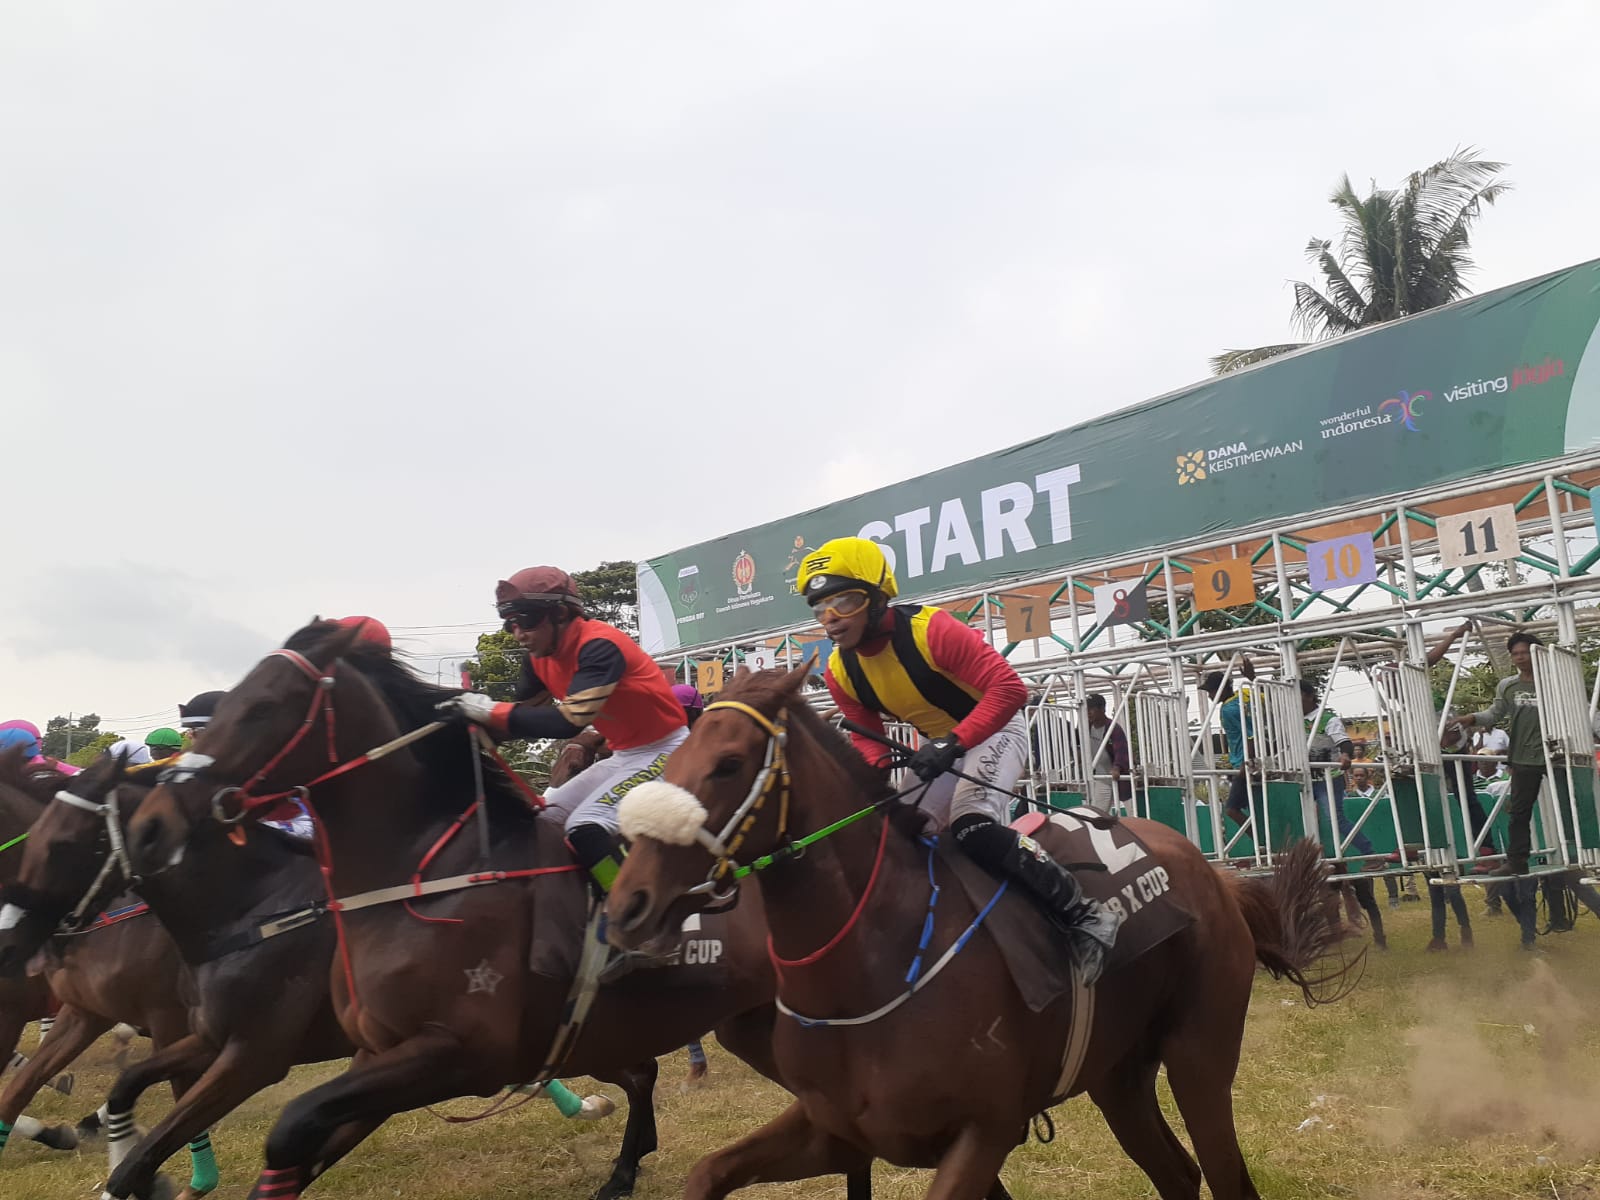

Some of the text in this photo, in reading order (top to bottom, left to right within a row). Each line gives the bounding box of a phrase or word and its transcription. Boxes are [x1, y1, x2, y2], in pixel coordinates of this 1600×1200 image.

[1443, 376, 1508, 402] visiting
[1319, 405, 1371, 426] wonderful
[1320, 413, 1393, 439] indonesia
[1207, 441, 1248, 461] DANA
[1208, 439, 1304, 474] KEISTIMEWAAN
[855, 463, 1081, 579] START
[1459, 516, 1499, 557] 11
[1321, 543, 1362, 582] 10
[1211, 569, 1231, 601] 9
[1112, 588, 1131, 618] 8
[1019, 605, 1034, 633] 7
[706, 666, 715, 687] 2
[755, 656, 765, 671] 3
[1121, 884, 1143, 914] X
[1136, 866, 1170, 903] CUP
[684, 939, 723, 965] CUP
